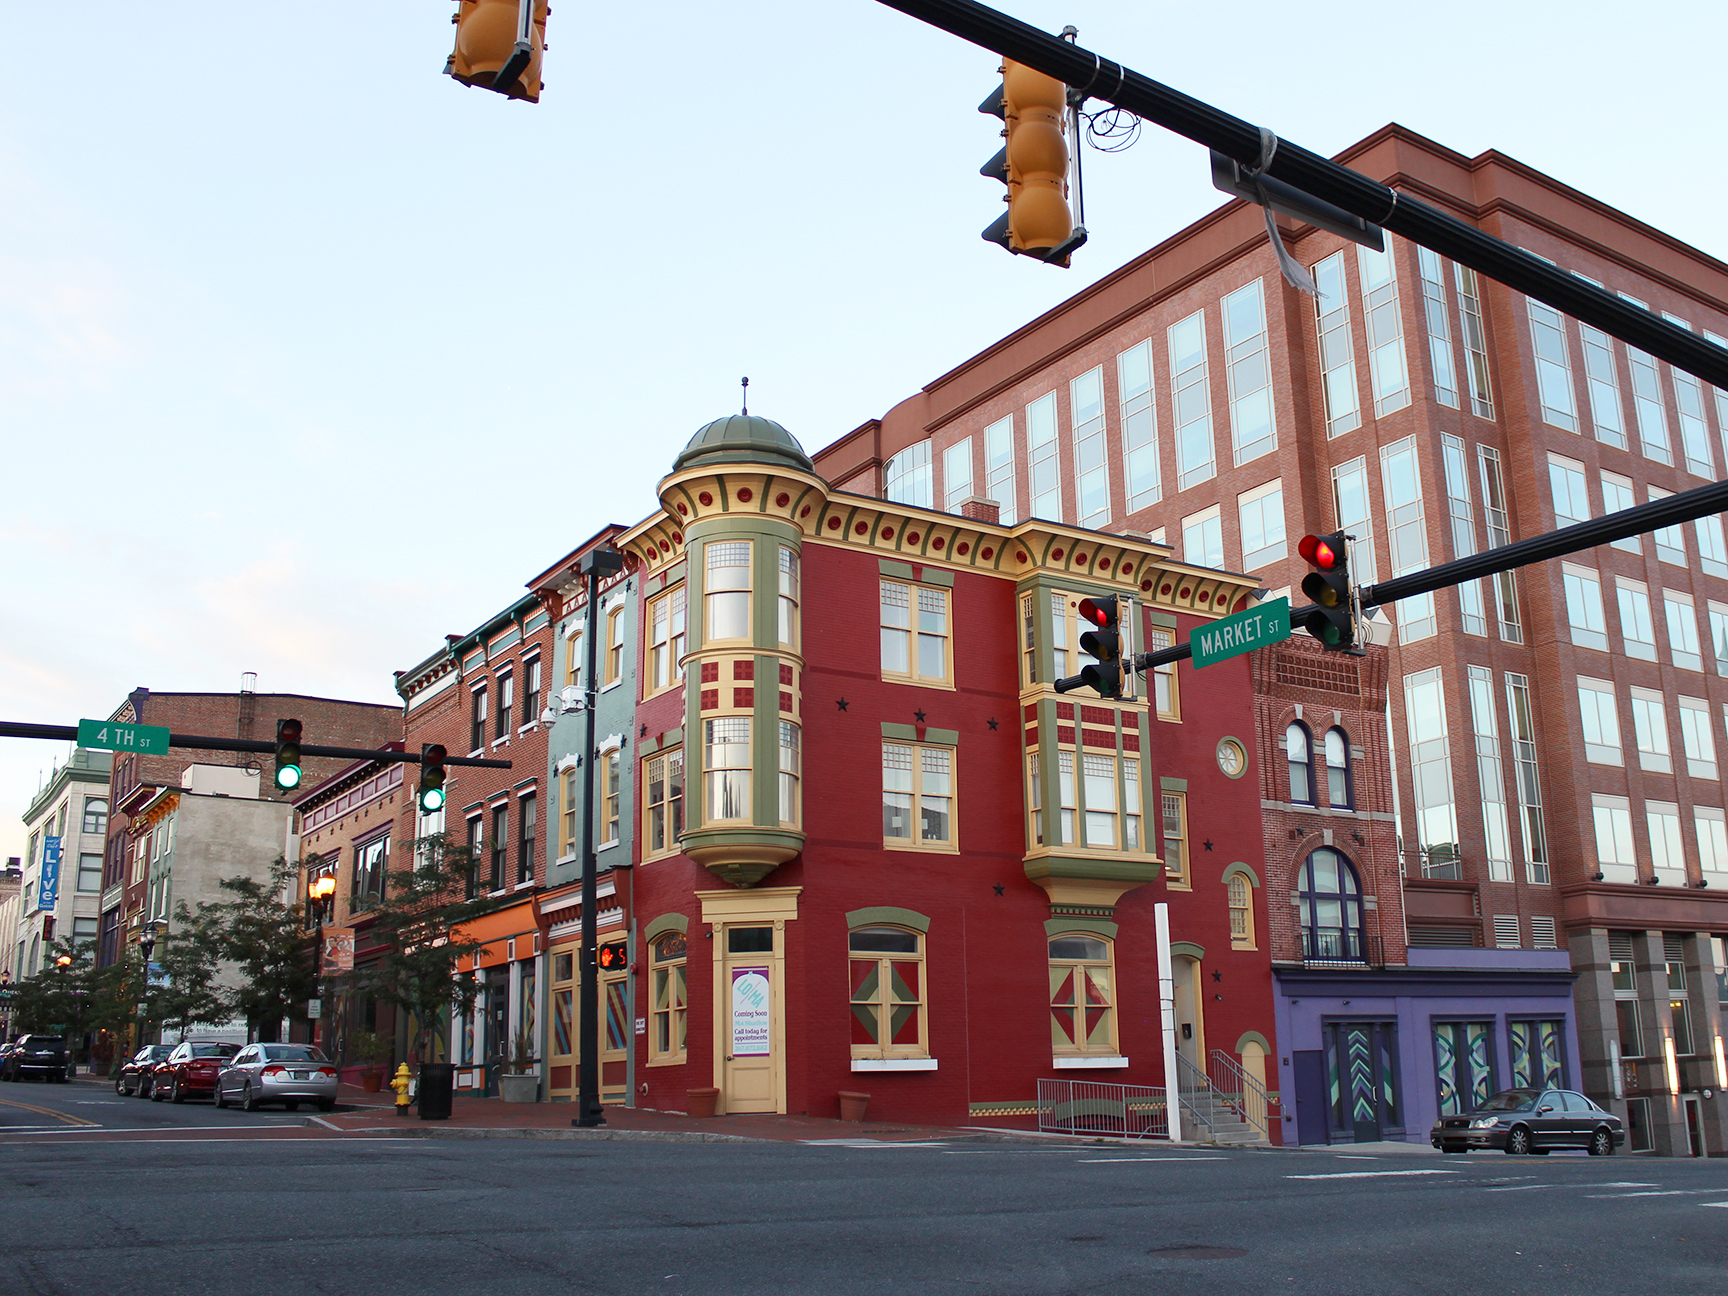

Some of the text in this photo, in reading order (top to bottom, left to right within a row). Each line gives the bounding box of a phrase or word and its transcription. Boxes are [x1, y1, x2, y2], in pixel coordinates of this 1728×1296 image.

[1201, 615, 1279, 656] MARKET ST
[97, 728, 150, 747] 4 TH ST
[619, 948, 626, 965] 5
[734, 1010, 754, 1018] Coming
